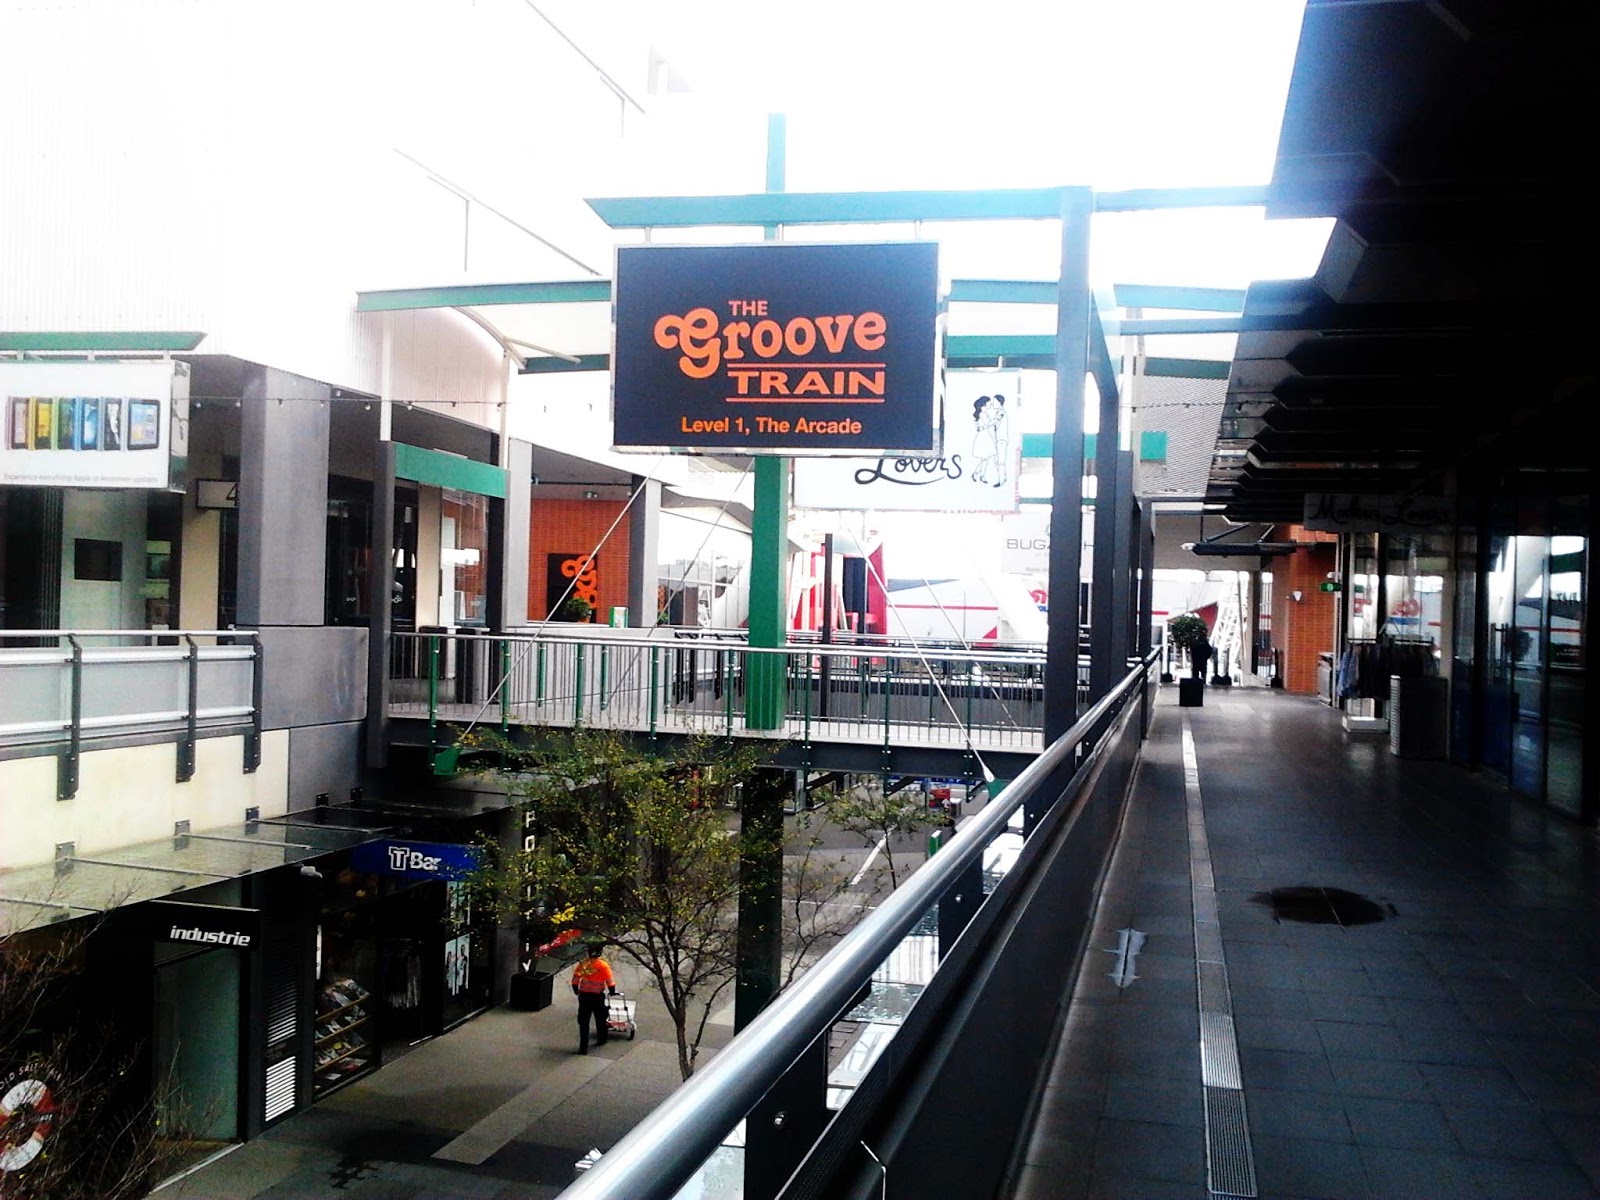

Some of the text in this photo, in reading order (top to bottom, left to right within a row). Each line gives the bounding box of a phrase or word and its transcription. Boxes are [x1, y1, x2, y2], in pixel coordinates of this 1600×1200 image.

[728, 300, 768, 316] THE
[727, 371, 886, 395] TRAIN
[681, 416, 862, 436] Level 1, The Arcade
[1006, 538, 1050, 550] BUG
[170, 925, 251, 947] industrie
